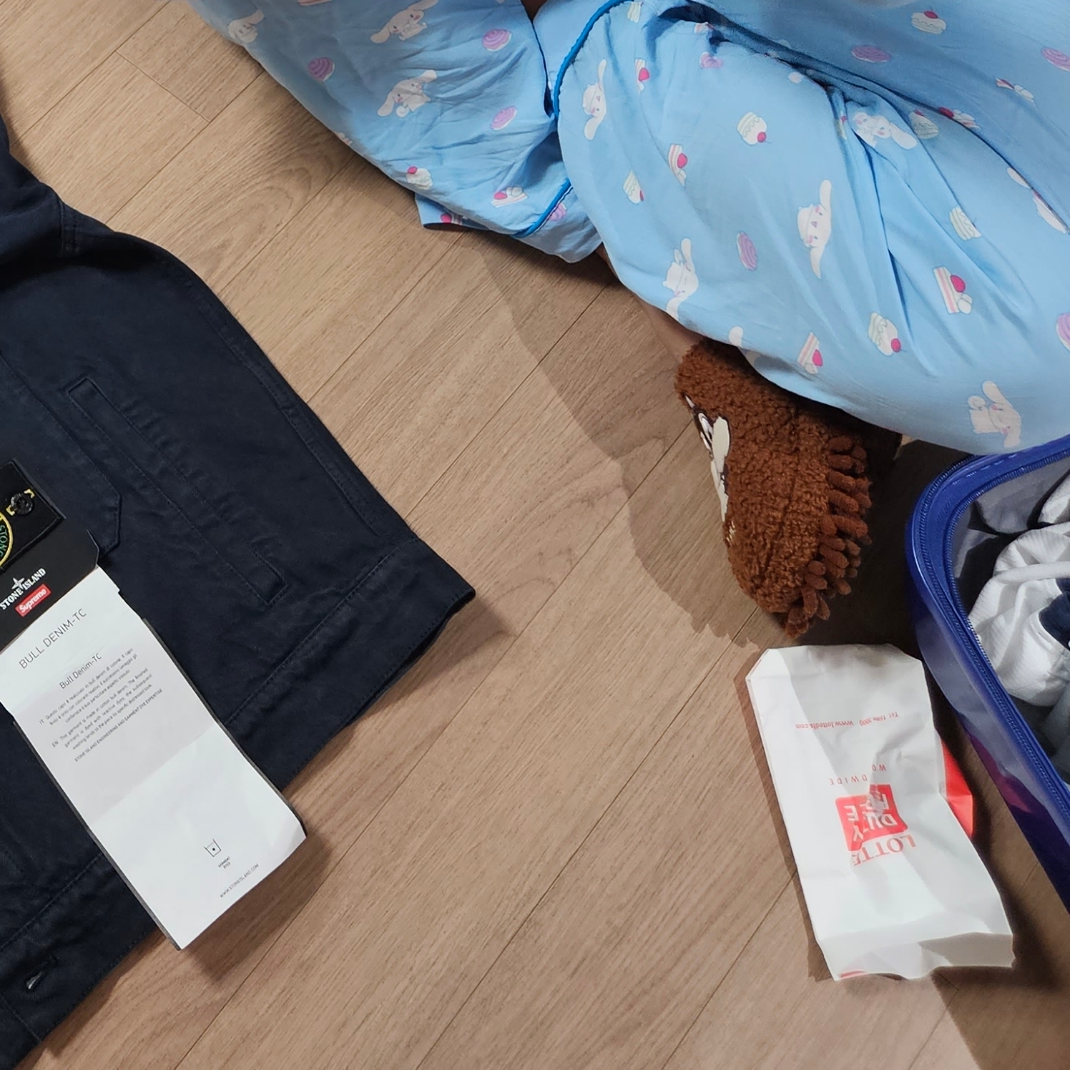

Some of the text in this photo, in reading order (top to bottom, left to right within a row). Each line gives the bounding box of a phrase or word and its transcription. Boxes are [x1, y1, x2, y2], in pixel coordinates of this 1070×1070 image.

[0, 568, 47, 610] STONE ISLAND
[19, 589, 47, 613] Supreme
[18, 608, 87, 669] BULL DENIM-TC
[59, 652, 102, 689] Bull Denim-TC
[830, 764, 886, 785] WODWIDE
[852, 834, 916, 866] LOTTE
